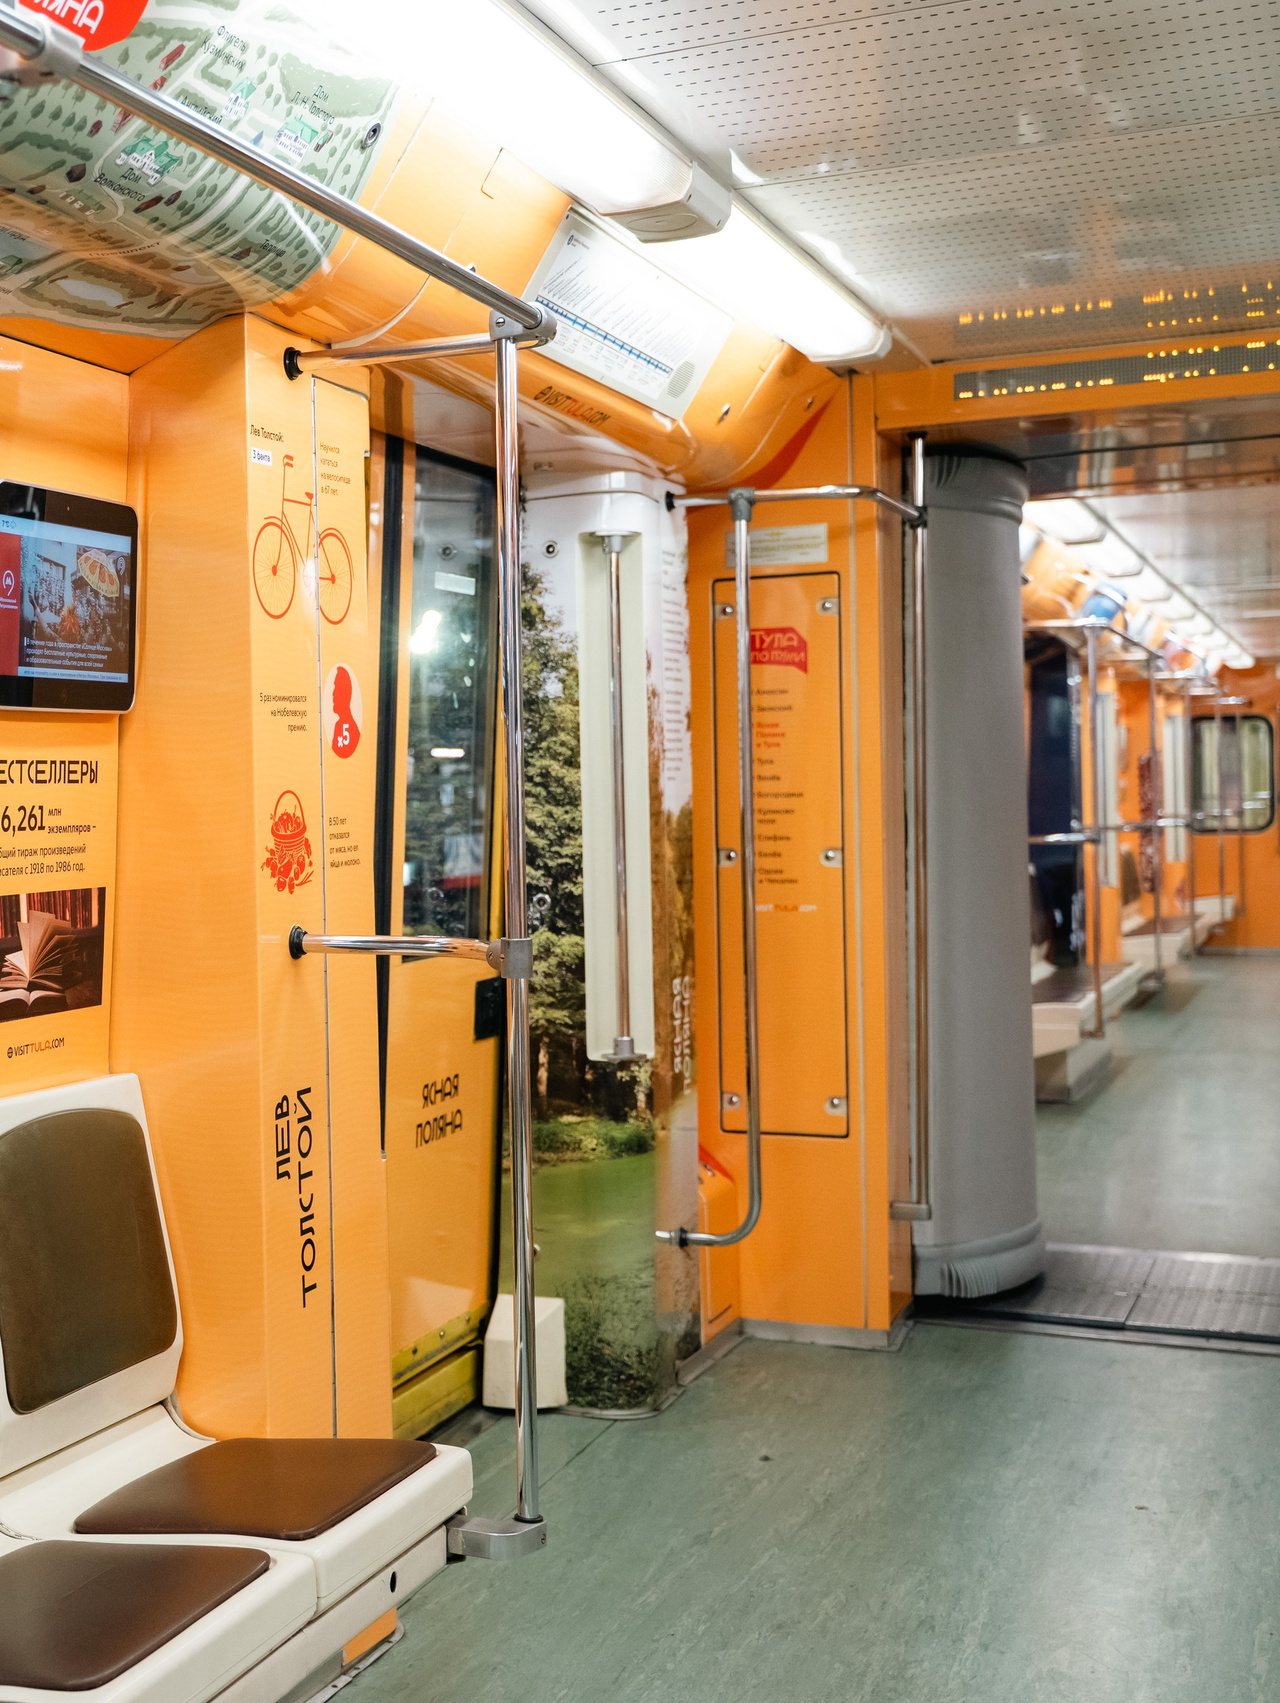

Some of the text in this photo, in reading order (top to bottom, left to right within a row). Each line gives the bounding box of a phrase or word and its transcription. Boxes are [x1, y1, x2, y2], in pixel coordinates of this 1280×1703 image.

[217, 25, 247, 52] Флигель
[201, 36, 246, 72] Кузминских
[312, 85, 329, 102] Дом
[309, 100, 335, 125] Толстого
[119, 167, 142, 184] Дом
[94, 172, 146, 202] Волконского
[260, 238, 287, 258] Теплица
[250, 424, 260, 436] Лев
[272, 694, 307, 703] номинировался
[270, 707, 307, 719] на Нобелевскую
[48, 808, 62, 817] млн
[47, 824, 91, 835] экземпляров
[17, 848, 39, 859] тираж
[40, 843, 86, 858] произведений
[24, 866, 29, 875] с
[30, 862, 45, 874] 1918
[46, 864, 55, 874] по
[56, 861, 71, 873] 1986
[72, 862, 86, 873] год.
[422, 1074, 459, 1109] ЯСНАЯ
[275, 1094, 291, 1180] ЛЕВ
[416, 1109, 463, 1149] ПОЛЯНА
[294, 1086, 317, 1309] ТОЛСТОЙ
